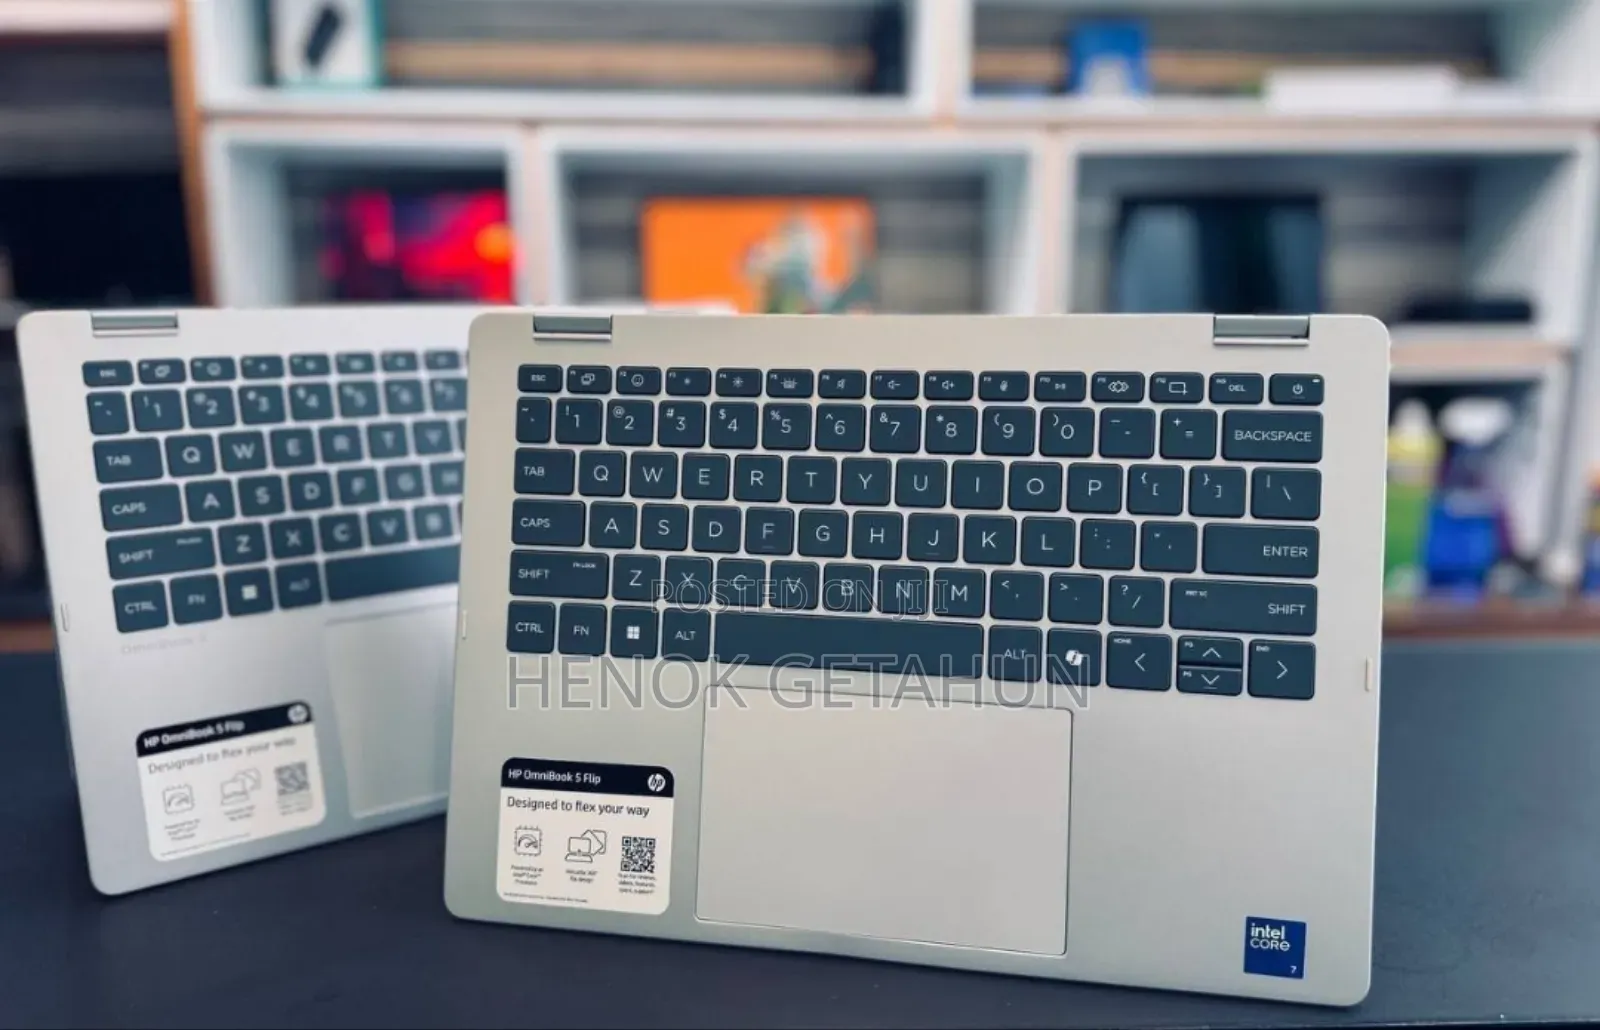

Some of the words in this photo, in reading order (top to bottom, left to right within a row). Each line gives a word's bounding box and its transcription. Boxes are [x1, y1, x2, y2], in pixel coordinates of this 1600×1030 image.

[531, 374, 546, 382] ESC
[1228, 384, 1246, 392] DEL
[613, 406, 625, 418] @
[573, 415, 580, 428] 1
[624, 416, 634, 430] 2
[676, 417, 686, 431] 3
[727, 419, 738, 432] 4
[781, 419, 791, 433] 5
[834, 420, 845, 435] 6
[890, 422, 900, 436] 7
[945, 422, 957, 437] 8
[1003, 423, 1014, 438] 9
[1234, 429, 1312, 442] BACKSPACE
[182, 446, 200, 463] Q
[232, 443, 254, 459] W
[106, 455, 132, 466] TAB
[523, 467, 545, 476] TAB
[593, 465, 609, 482] Q
[642, 467, 664, 483] W
[698, 468, 711, 485] E
[750, 471, 764, 486] R
[805, 472, 818, 487] T
[858, 474, 872, 490] Y
[914, 475, 928, 491] U
[1027, 478, 1044, 495] O
[1089, 480, 1102, 496] P
[112, 502, 147, 515] CAPS
[203, 493, 220, 509] A
[520, 518, 551, 528] CAPS
[604, 518, 620, 534] A
[658, 519, 670, 536] S
[709, 521, 723, 537] D
[762, 523, 775, 538] F
[815, 525, 830, 541] G
[870, 528, 884, 543] H
[928, 529, 939, 546] J
[982, 531, 996, 548] K
[236, 535, 251, 553] Z
[1042, 533, 1053, 550] L
[119, 550, 153, 563] SHIFT
[1263, 545, 1308, 557] ENTER
[518, 568, 550, 580] SHIFT
[629, 570, 643, 586] Z
[682, 572, 695, 588] X
[734, 575, 748, 591] C
[787, 577, 801, 593] V
[841, 579, 854, 595] B
[896, 582, 910, 598] N
[951, 585, 968, 601] M
[125, 601, 157, 614] CTRL
[1268, 603, 1306, 615] SHIFT
[515, 623, 544, 634] CTRL
[573, 625, 589, 636] FN
[675, 631, 696, 641] ALT
[1004, 649, 1027, 659] ALT
[144, 736, 159, 748] HP
[148, 756, 204, 774] Designed
[508, 769, 522, 779] HP
[524, 770, 573, 782] OmniBook
[575, 773, 581, 782] 5
[584, 773, 601, 786] Flip
[649, 774, 665, 791] hp
[507, 796, 558, 812] Designed
[561, 800, 573, 811] to
[576, 800, 596, 812] flex
[598, 804, 624, 816] your
[626, 806, 650, 818] way
[1250, 922, 1285, 939] intel
[1290, 965, 1297, 974] 7
